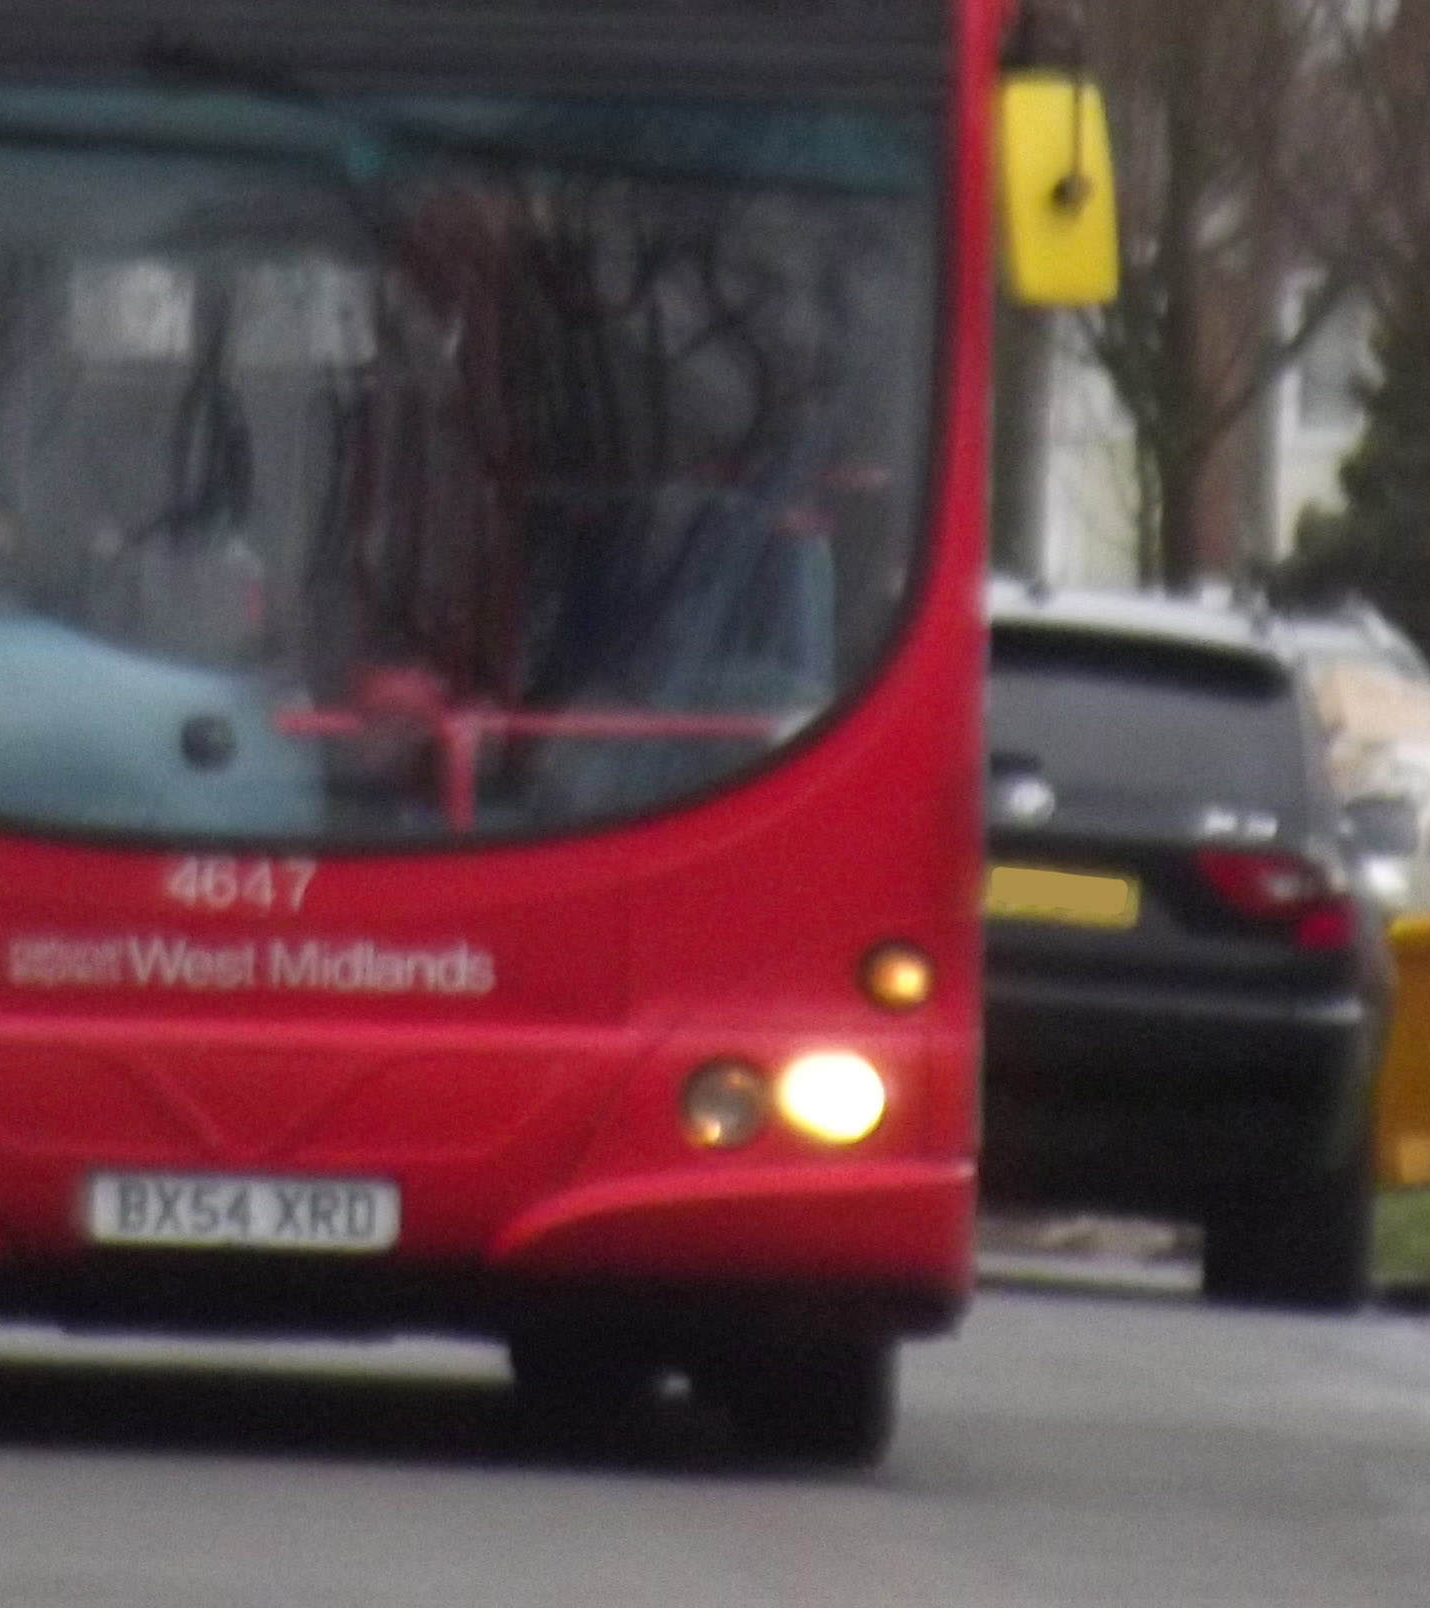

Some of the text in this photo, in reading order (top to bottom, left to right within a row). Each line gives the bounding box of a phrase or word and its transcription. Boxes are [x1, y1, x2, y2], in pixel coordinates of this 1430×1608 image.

[168, 855, 318, 911] 4647
[271, 940, 495, 992] Midlands
[117, 1182, 253, 1238] BX54
